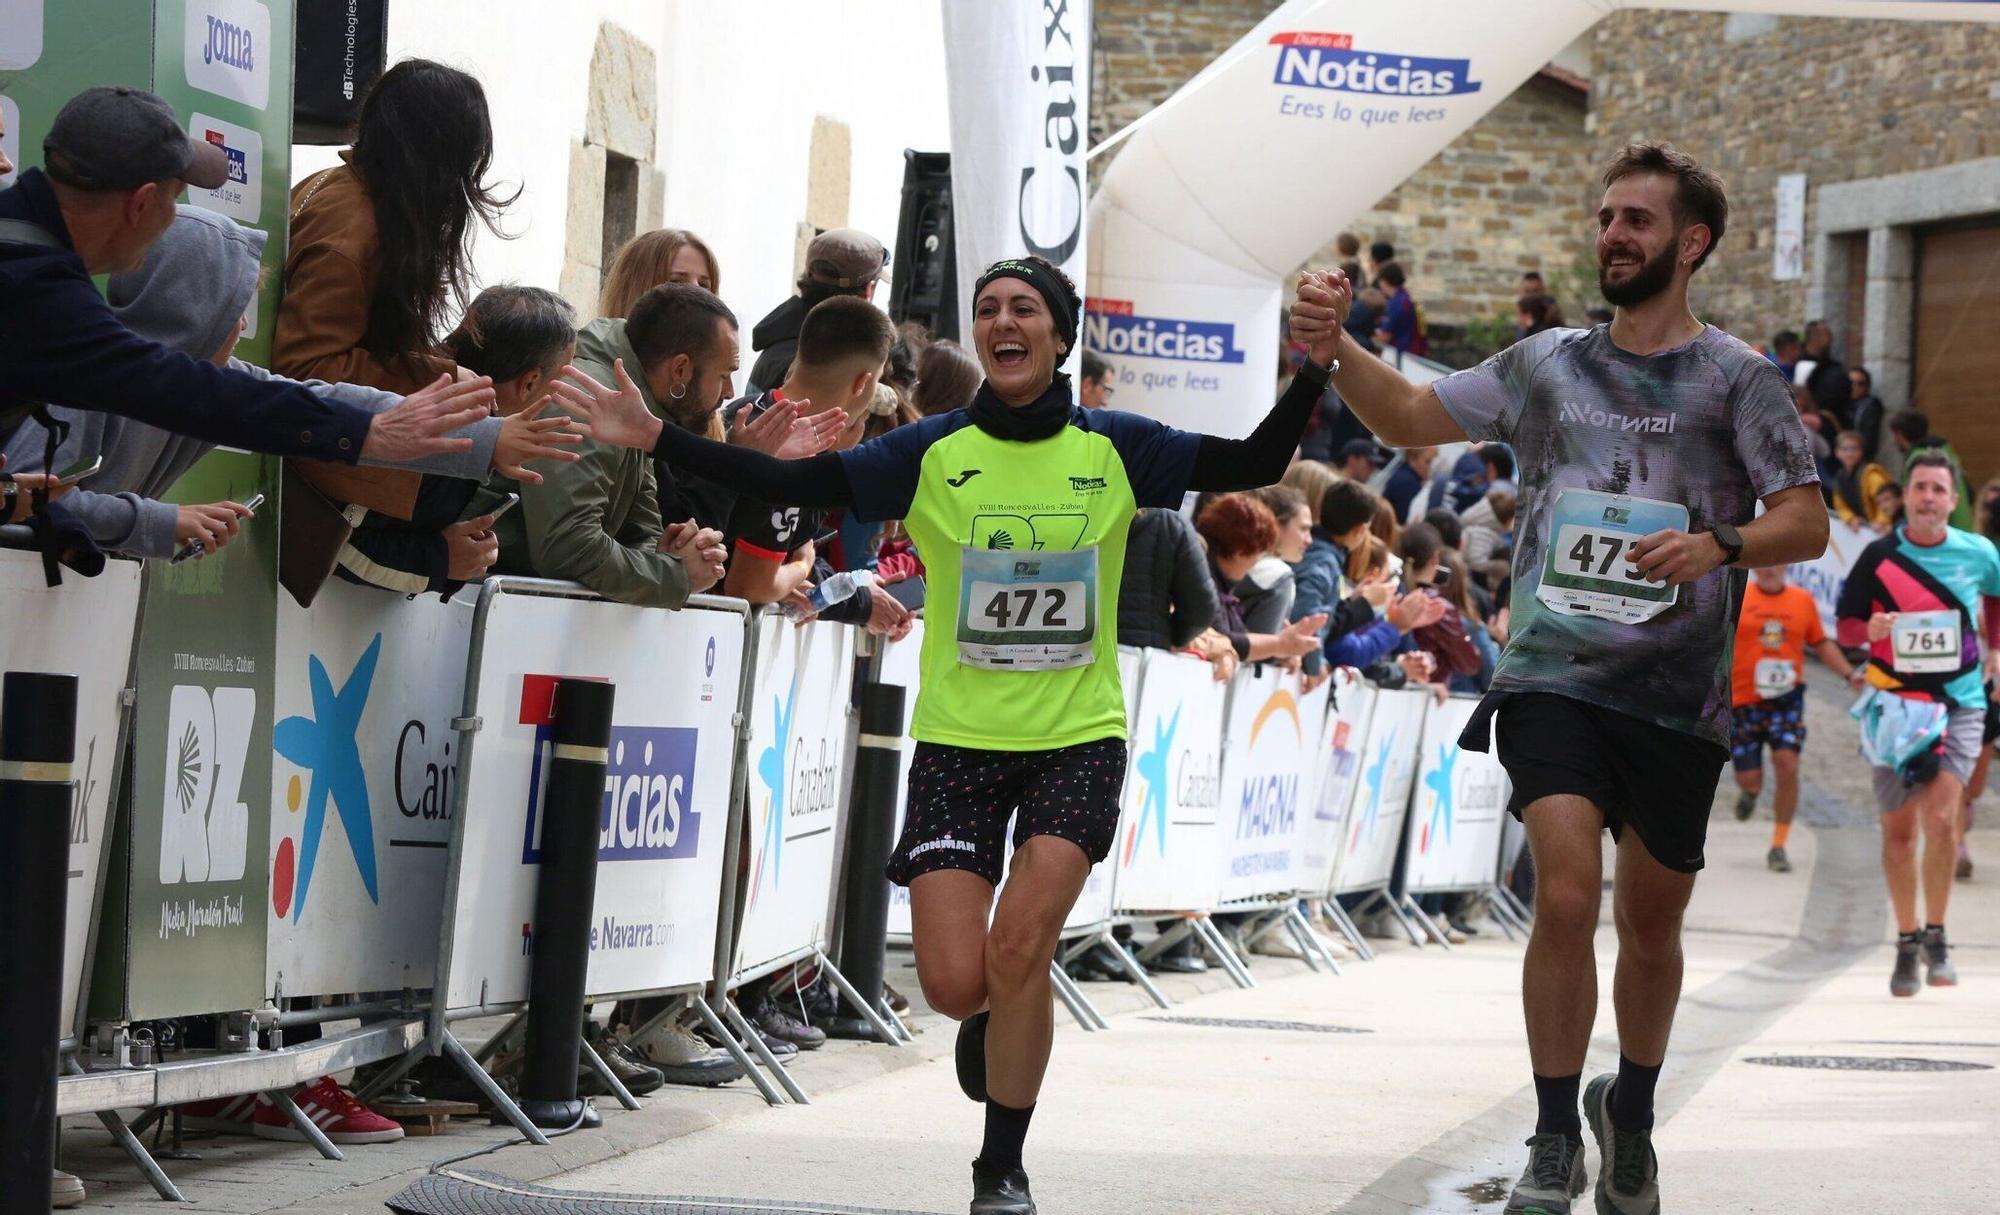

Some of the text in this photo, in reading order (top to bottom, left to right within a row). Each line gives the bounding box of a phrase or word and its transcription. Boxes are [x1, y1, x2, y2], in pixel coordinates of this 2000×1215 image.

[343, 0, 358, 100] dBTechnologies
[1292, 34, 1350, 48] Diario de
[1281, 47, 1455, 95] Noticias
[1280, 95, 1447, 128] Eres lo que lees
[1083, 314, 1225, 361] Noticias
[1119, 365, 1220, 391] lo que lees
[985, 588, 1067, 628] 472
[1906, 632, 1946, 650] 764
[159, 685, 257, 885] RZ
[1236, 772, 1298, 841] MAGNA
[909, 836, 977, 861] IRONMAN
[159, 895, 244, 940] Media Maratón Trail
